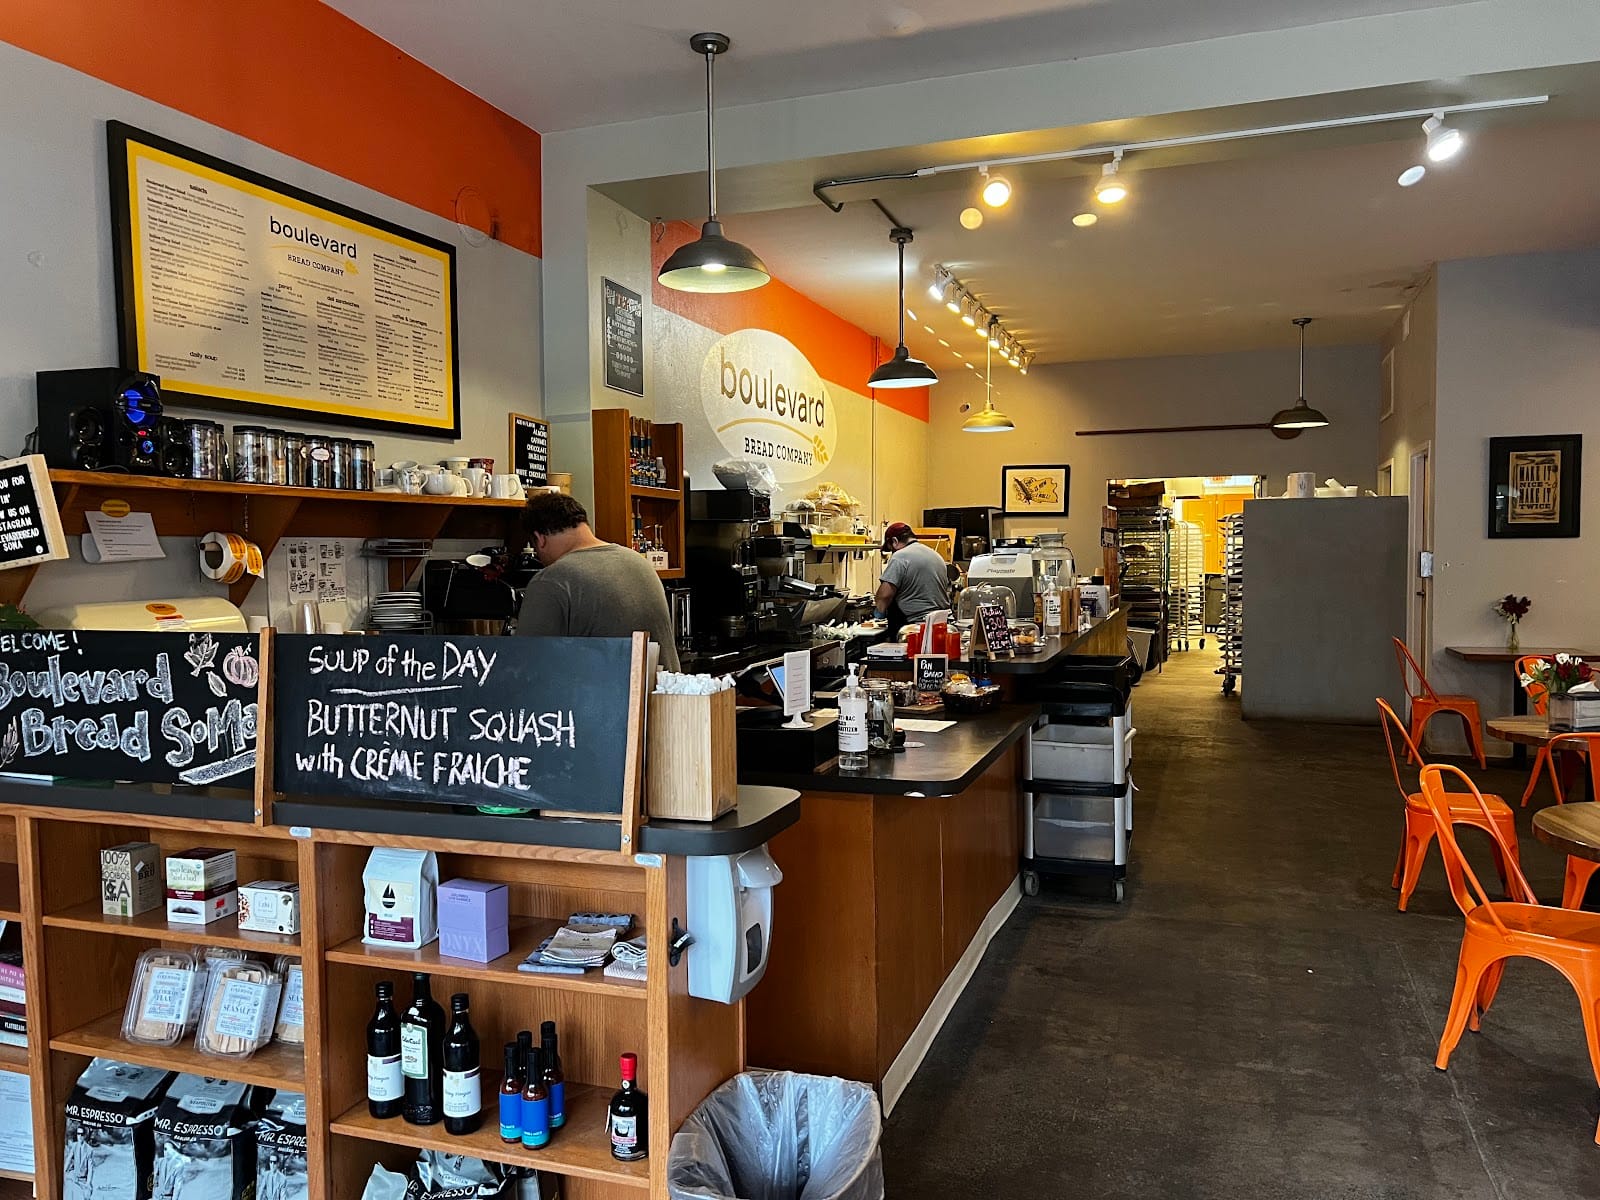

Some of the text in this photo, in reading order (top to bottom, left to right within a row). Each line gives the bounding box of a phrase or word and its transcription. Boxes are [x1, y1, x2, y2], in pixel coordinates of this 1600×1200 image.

[270, 215, 358, 259] boulevard
[287, 254, 345, 277] BREAD COMPANY
[720, 346, 825, 428] boulevard
[744, 437, 813, 467] BREAD COMPANY
[0, 475, 26, 490] OU FOR
[1519, 465, 1551, 482] MAKE IT
[1519, 487, 1551, 504] MAKE IT
[7, 504, 31, 518] US ON
[2, 540, 24, 552] SOMA
[0, 631, 83, 655] ELCOME!
[308, 641, 498, 687] SOUP of the DAY
[920, 659, 933, 670] PAN
[21, 699, 258, 768] Bread SoMa
[307, 699, 576, 749] BUTTERNUT SQUASH
[295, 742, 344, 779] with
[433, 752, 532, 791] FRAICHE
[101, 850, 130, 866] 100%
[442, 930, 484, 954] ONYX
[65, 1103, 124, 1124] MR. ESPRESSO
[154, 1116, 224, 1137] MR. ESPRESSO
[276, 1133, 307, 1148] ESPRE
